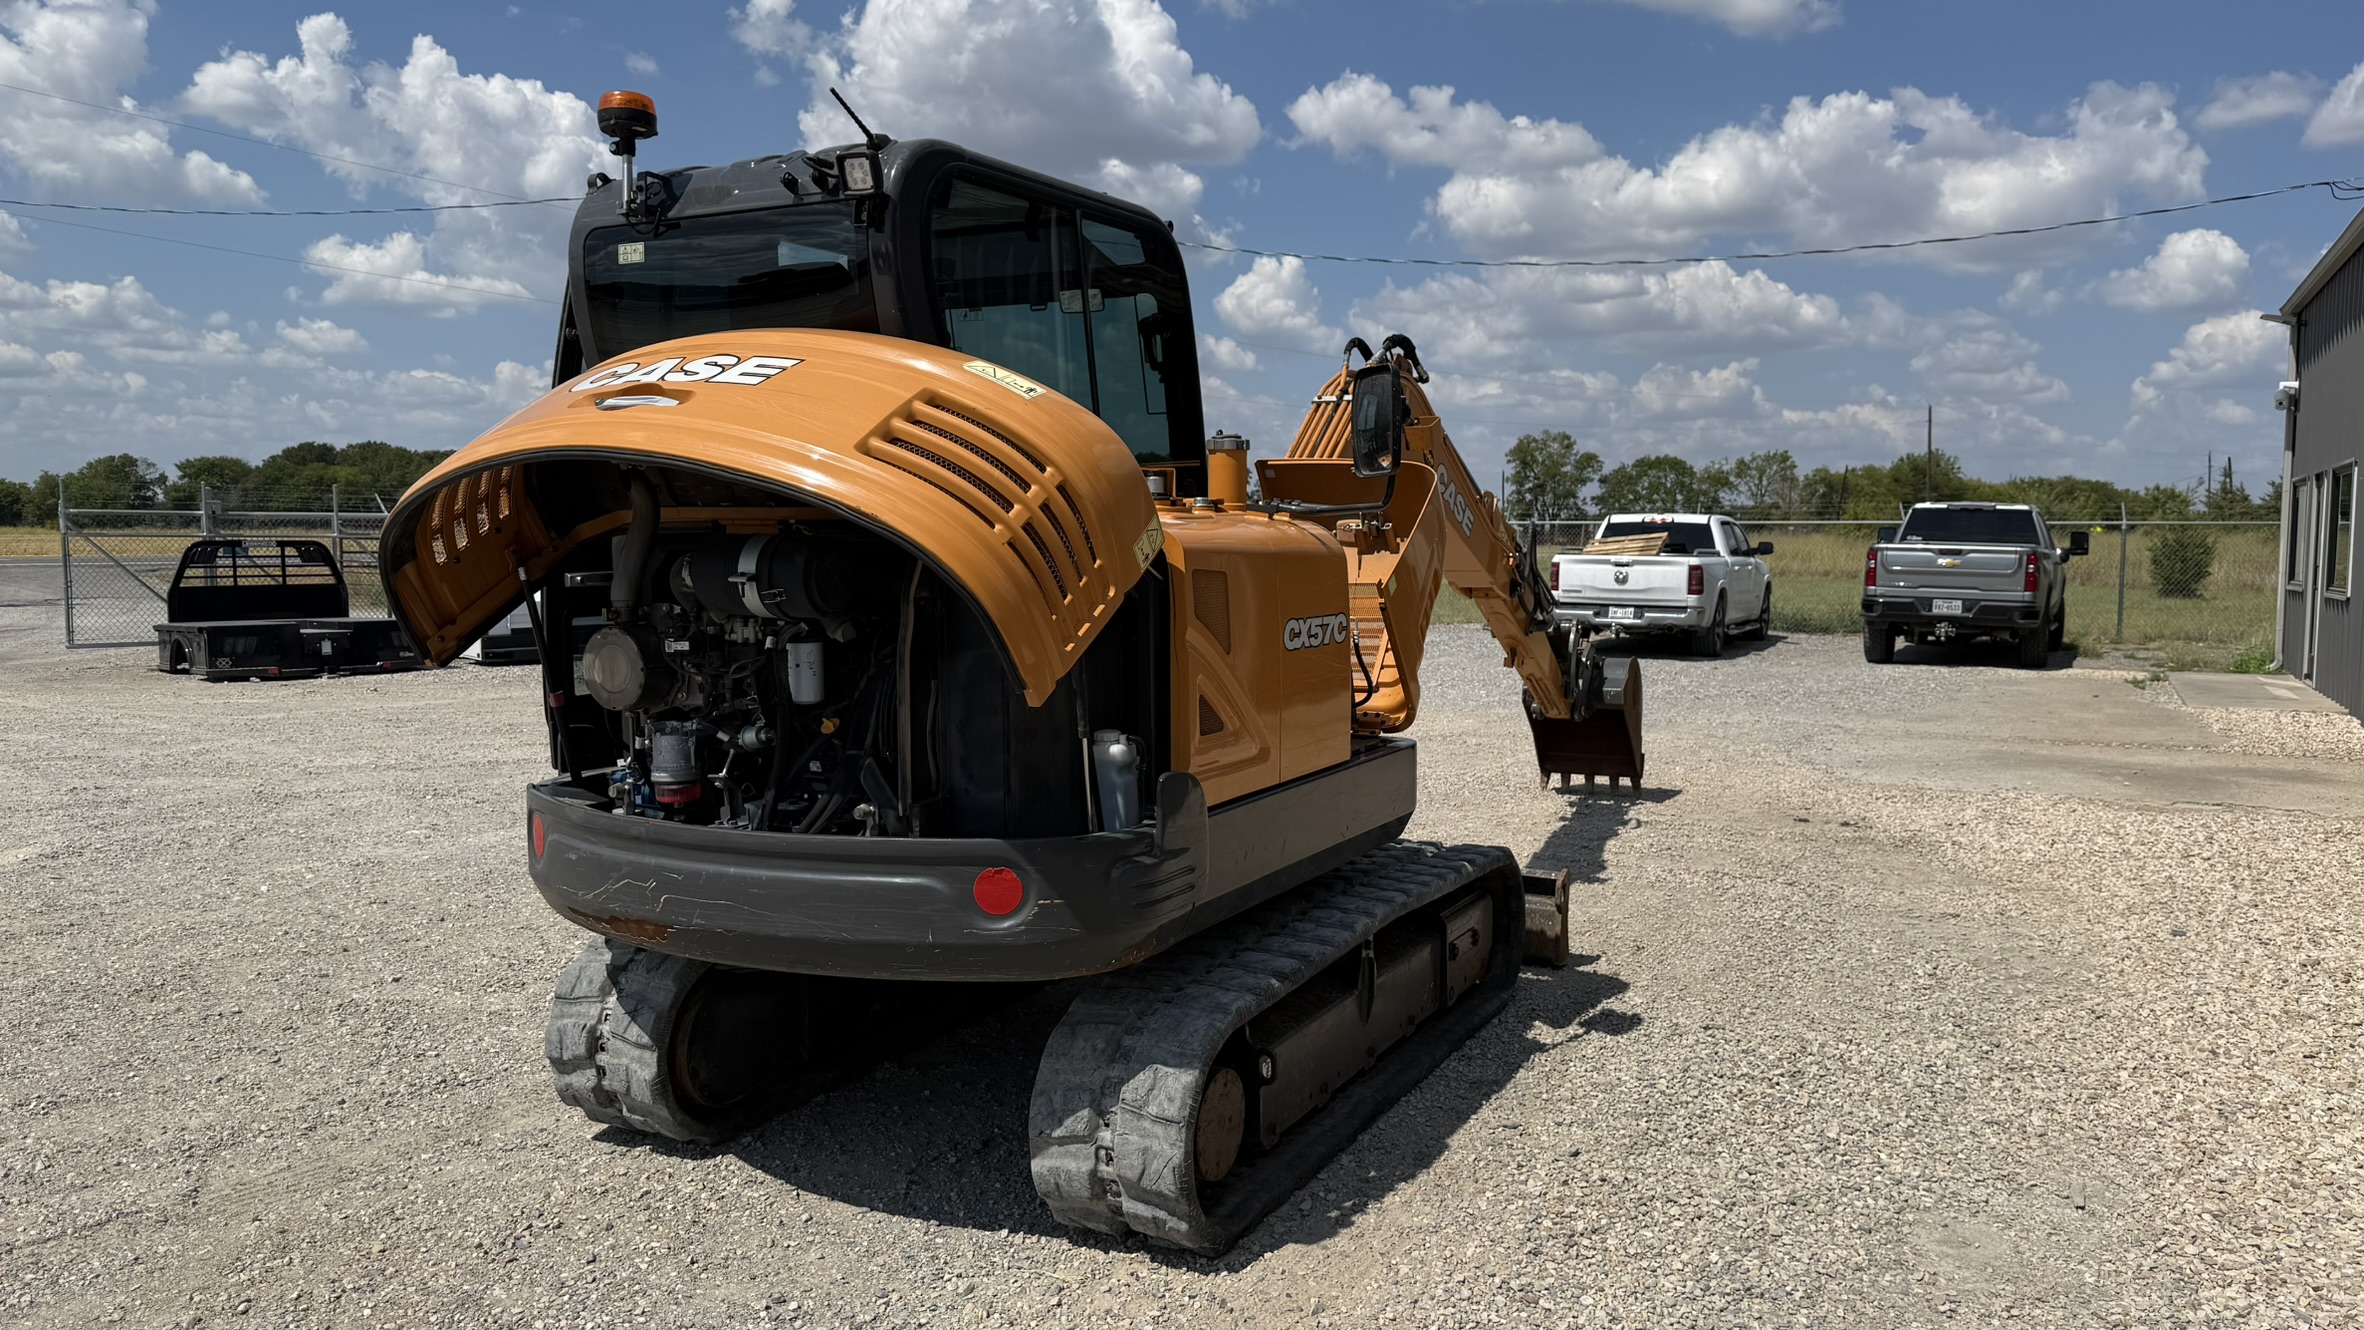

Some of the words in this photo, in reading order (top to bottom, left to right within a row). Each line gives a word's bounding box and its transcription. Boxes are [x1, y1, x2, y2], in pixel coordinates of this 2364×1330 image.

[568, 353, 806, 393] CASE
[1437, 463, 1475, 539] CASE
[1283, 612, 1347, 651] CX57C
